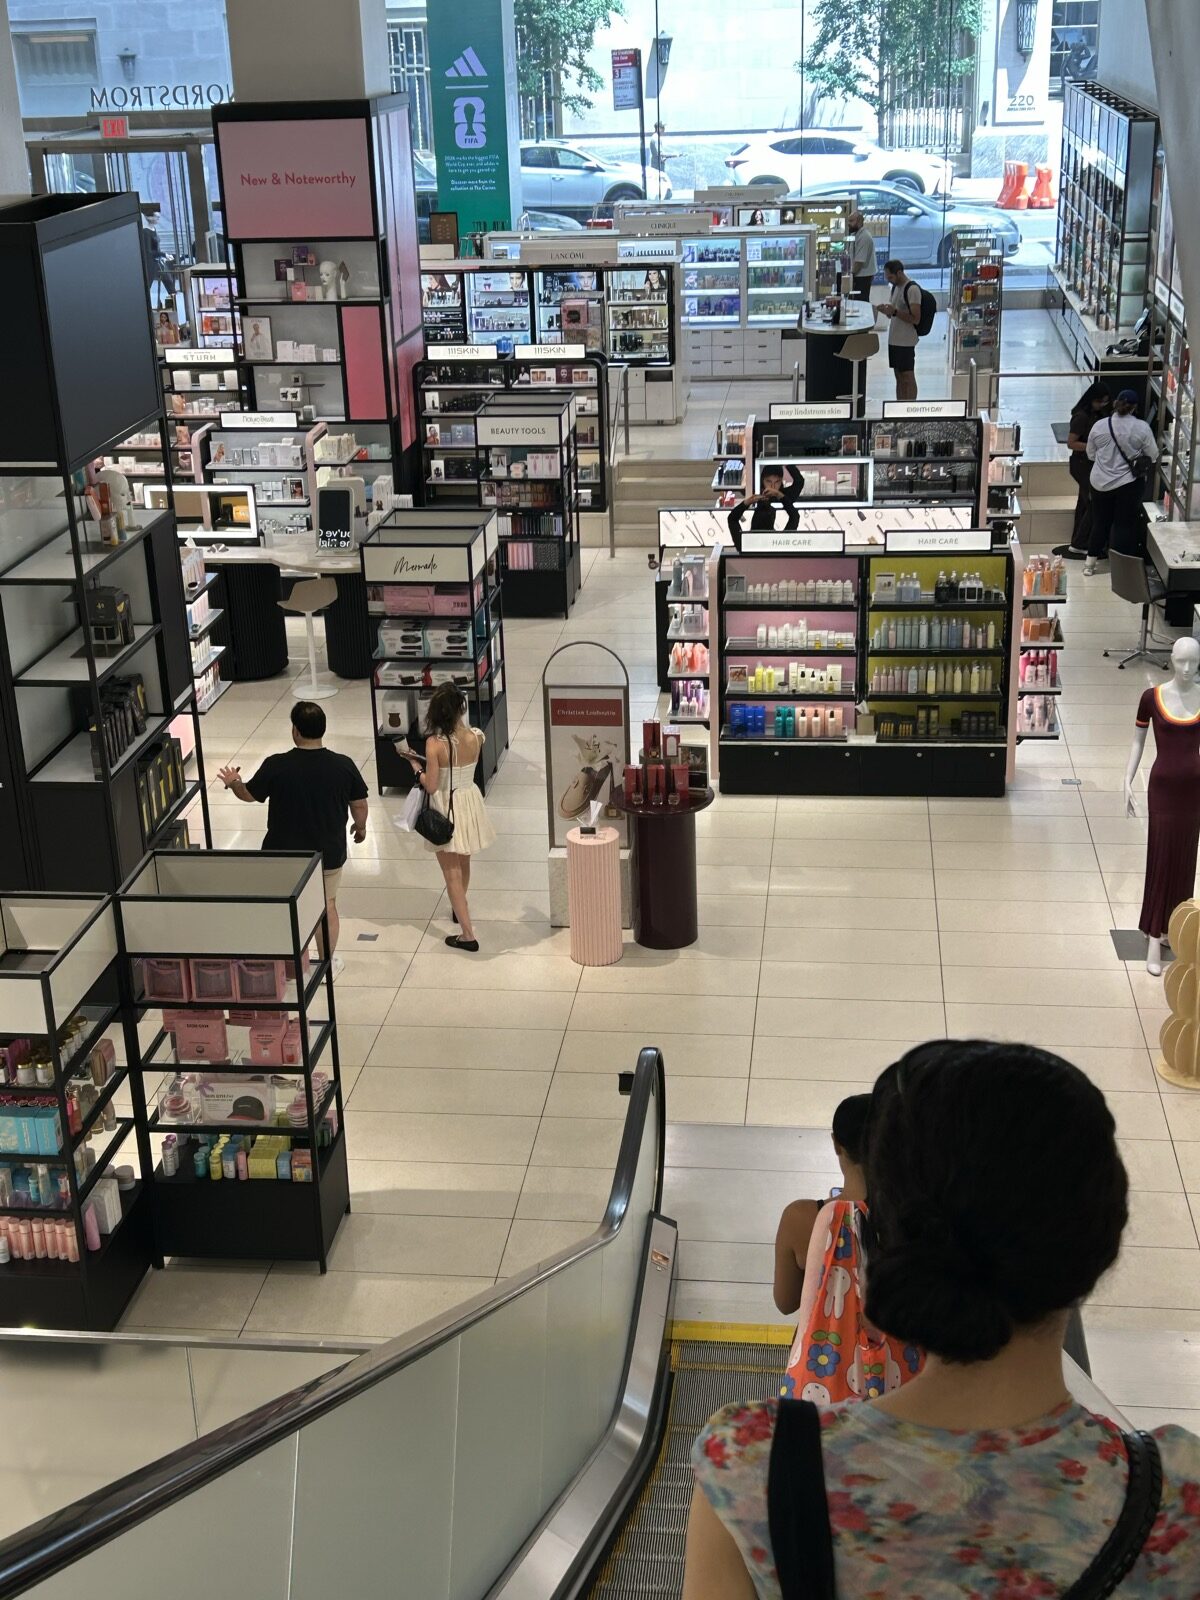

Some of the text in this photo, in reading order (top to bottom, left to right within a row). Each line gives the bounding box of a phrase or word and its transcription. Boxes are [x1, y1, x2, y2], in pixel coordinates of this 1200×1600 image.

[1009, 95, 1034, 106] 220
[241, 171, 356, 188] New & Noteworthy
[779, 408, 793, 417] may
[827, 407, 841, 415] skin
[393, 552, 438, 575] Mermade
